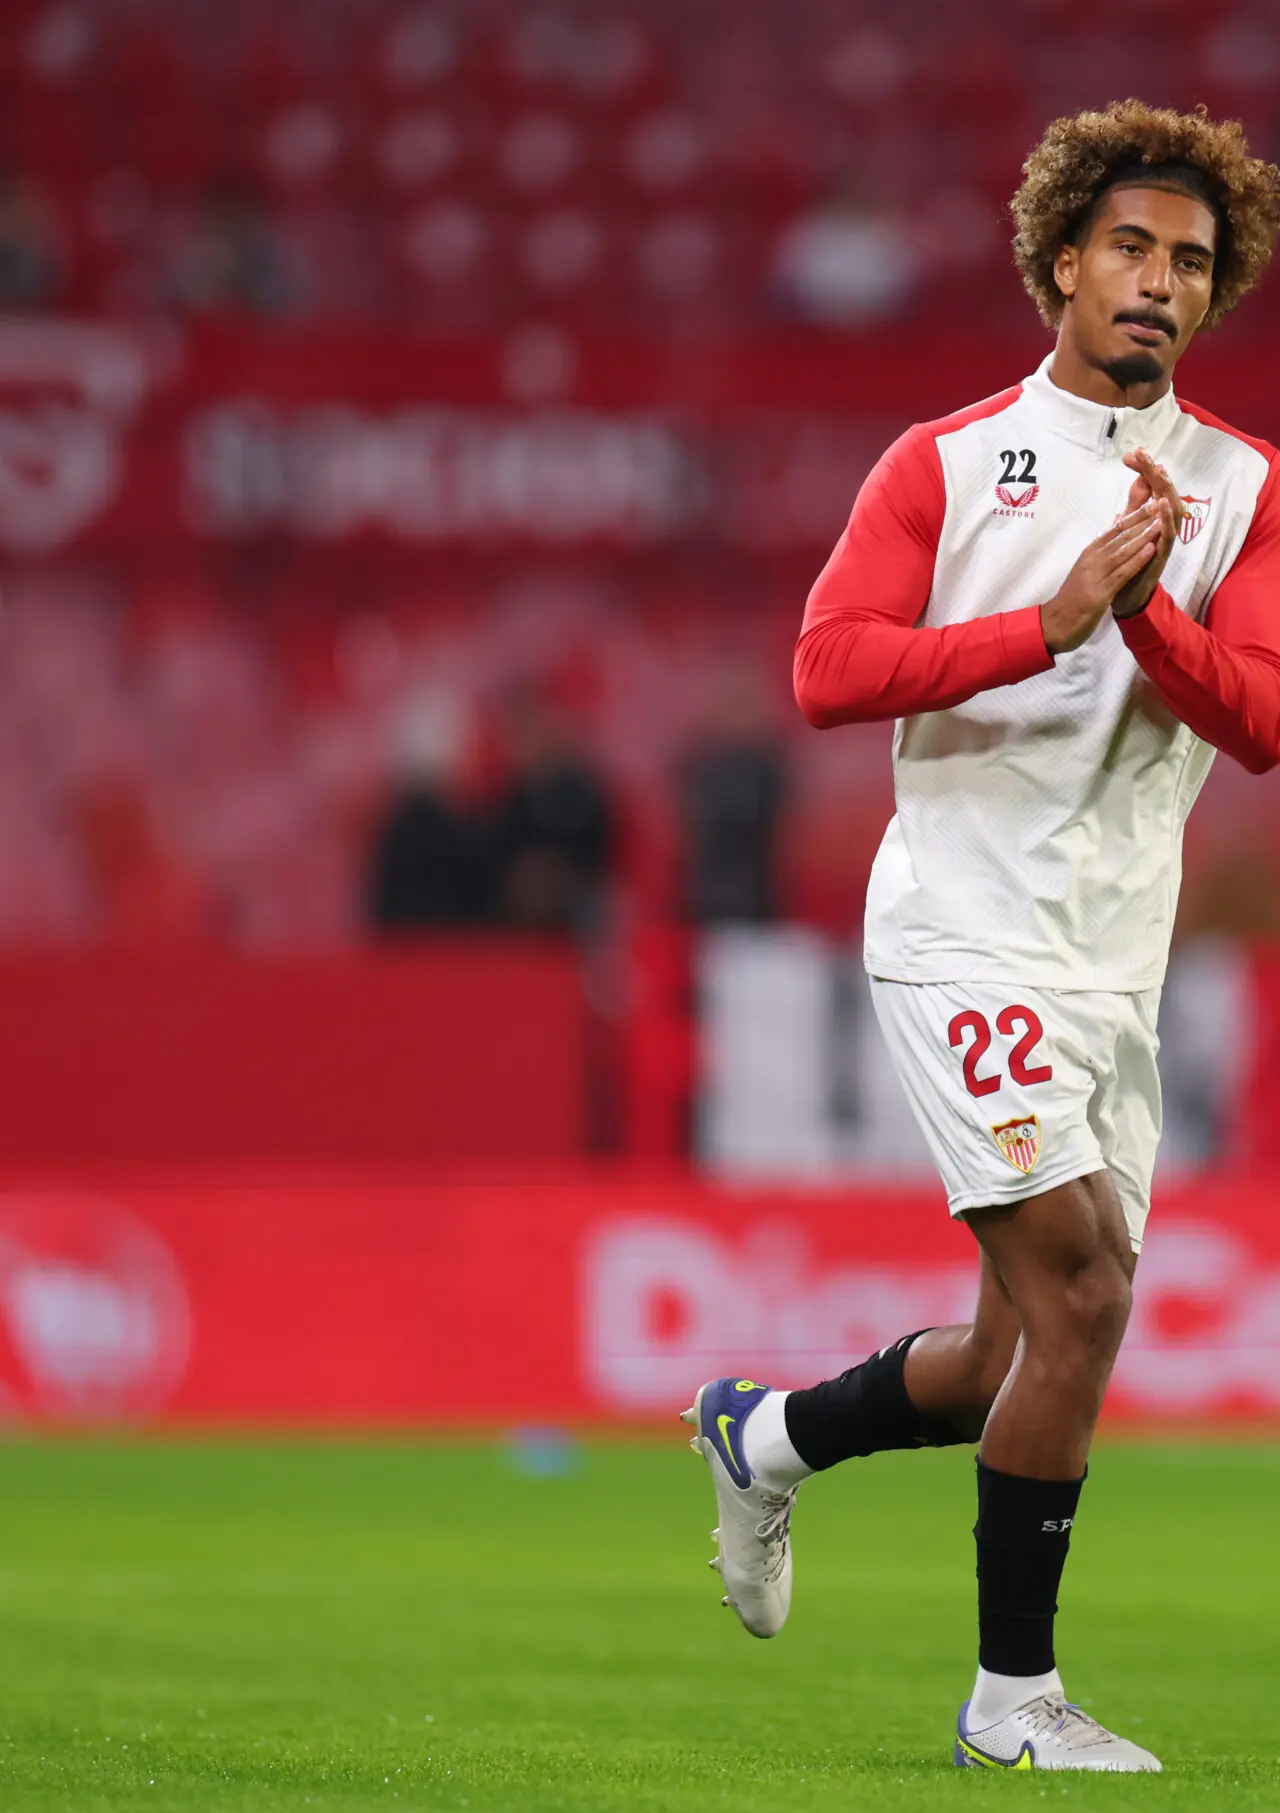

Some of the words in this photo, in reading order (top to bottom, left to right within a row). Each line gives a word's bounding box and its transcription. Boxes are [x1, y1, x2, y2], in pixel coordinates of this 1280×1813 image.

[997, 449, 1038, 484] 22
[992, 508, 1036, 518] CASTORE
[948, 1005, 1052, 1098] 22
